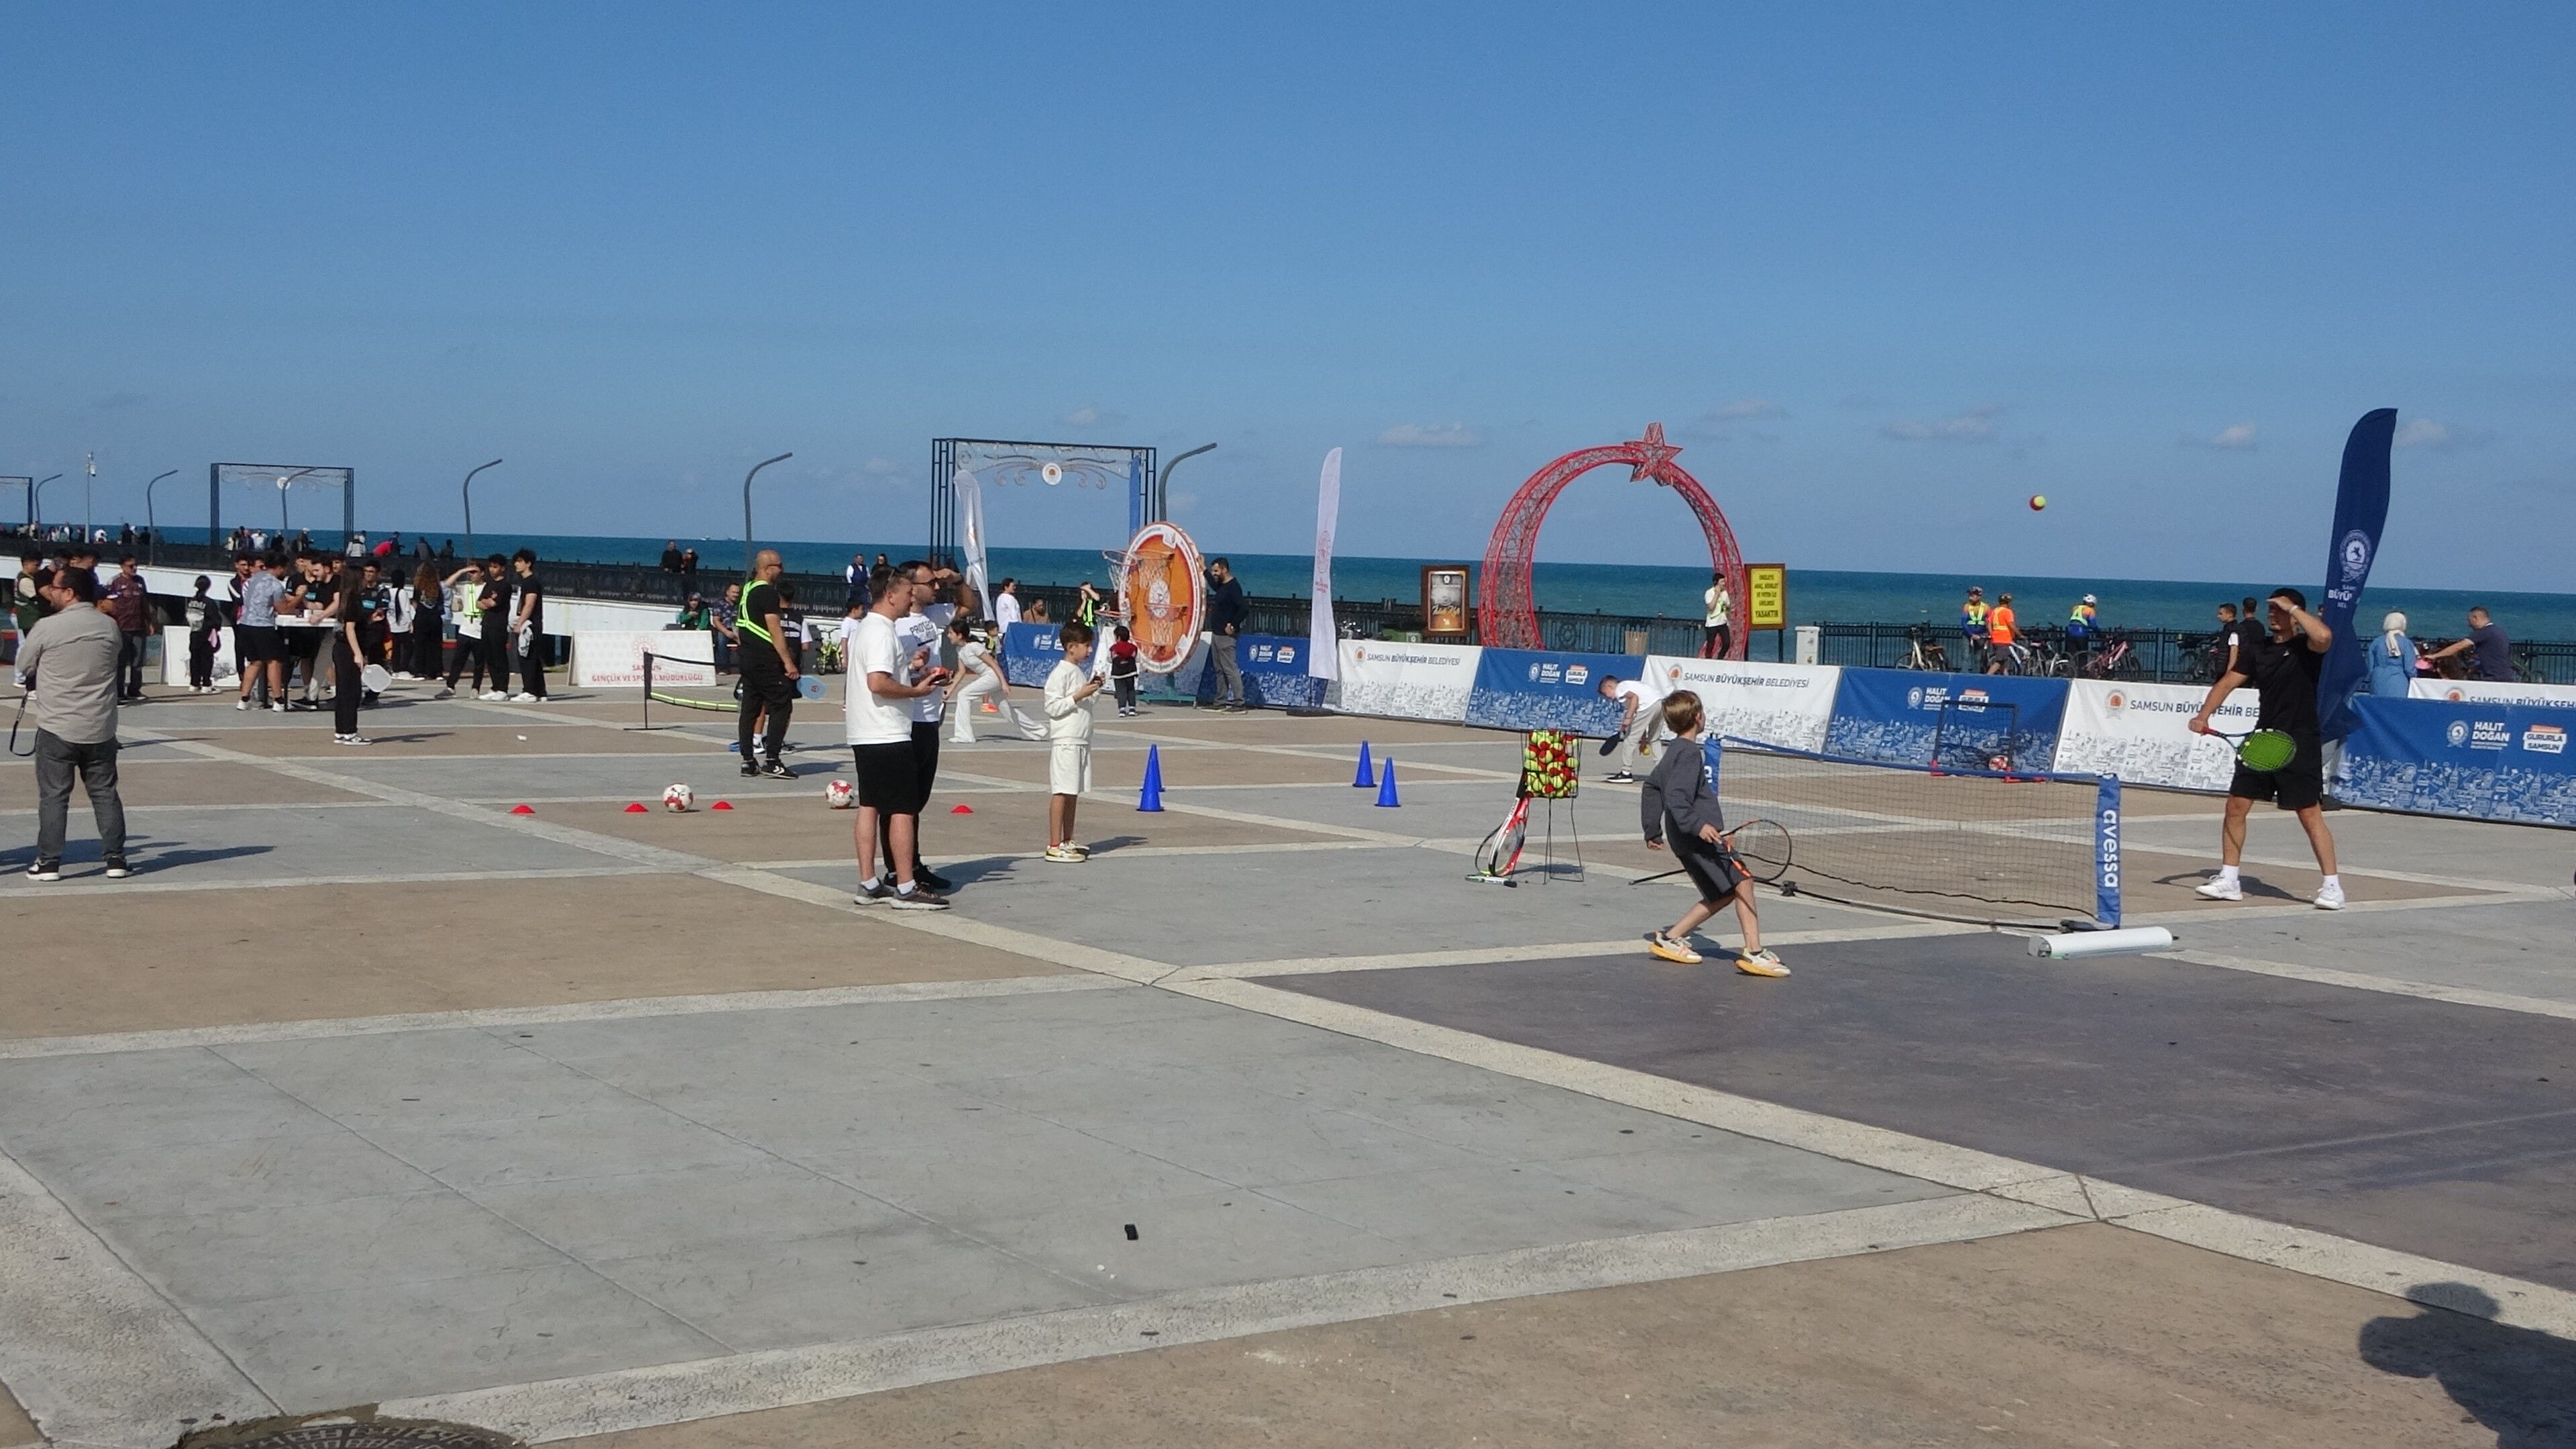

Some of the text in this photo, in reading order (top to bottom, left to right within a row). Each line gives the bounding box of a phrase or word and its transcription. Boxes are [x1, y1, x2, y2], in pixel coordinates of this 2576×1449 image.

[1367, 653, 1390, 661] SAMSUN
[1391, 653, 1427, 665] BÜYÜKŞEHİR
[1684, 672, 1810, 688] SAMSUN BÜYÜKŞEHİR BELEDİYESİ
[2130, 700, 2173, 712] SAMSUN
[2176, 701, 2243, 717] BÜYÜEHİR
[2526, 734, 2563, 742] GURURLA
[2527, 743, 2559, 751] SAMSUN
[2102, 809, 2118, 888] avessa
